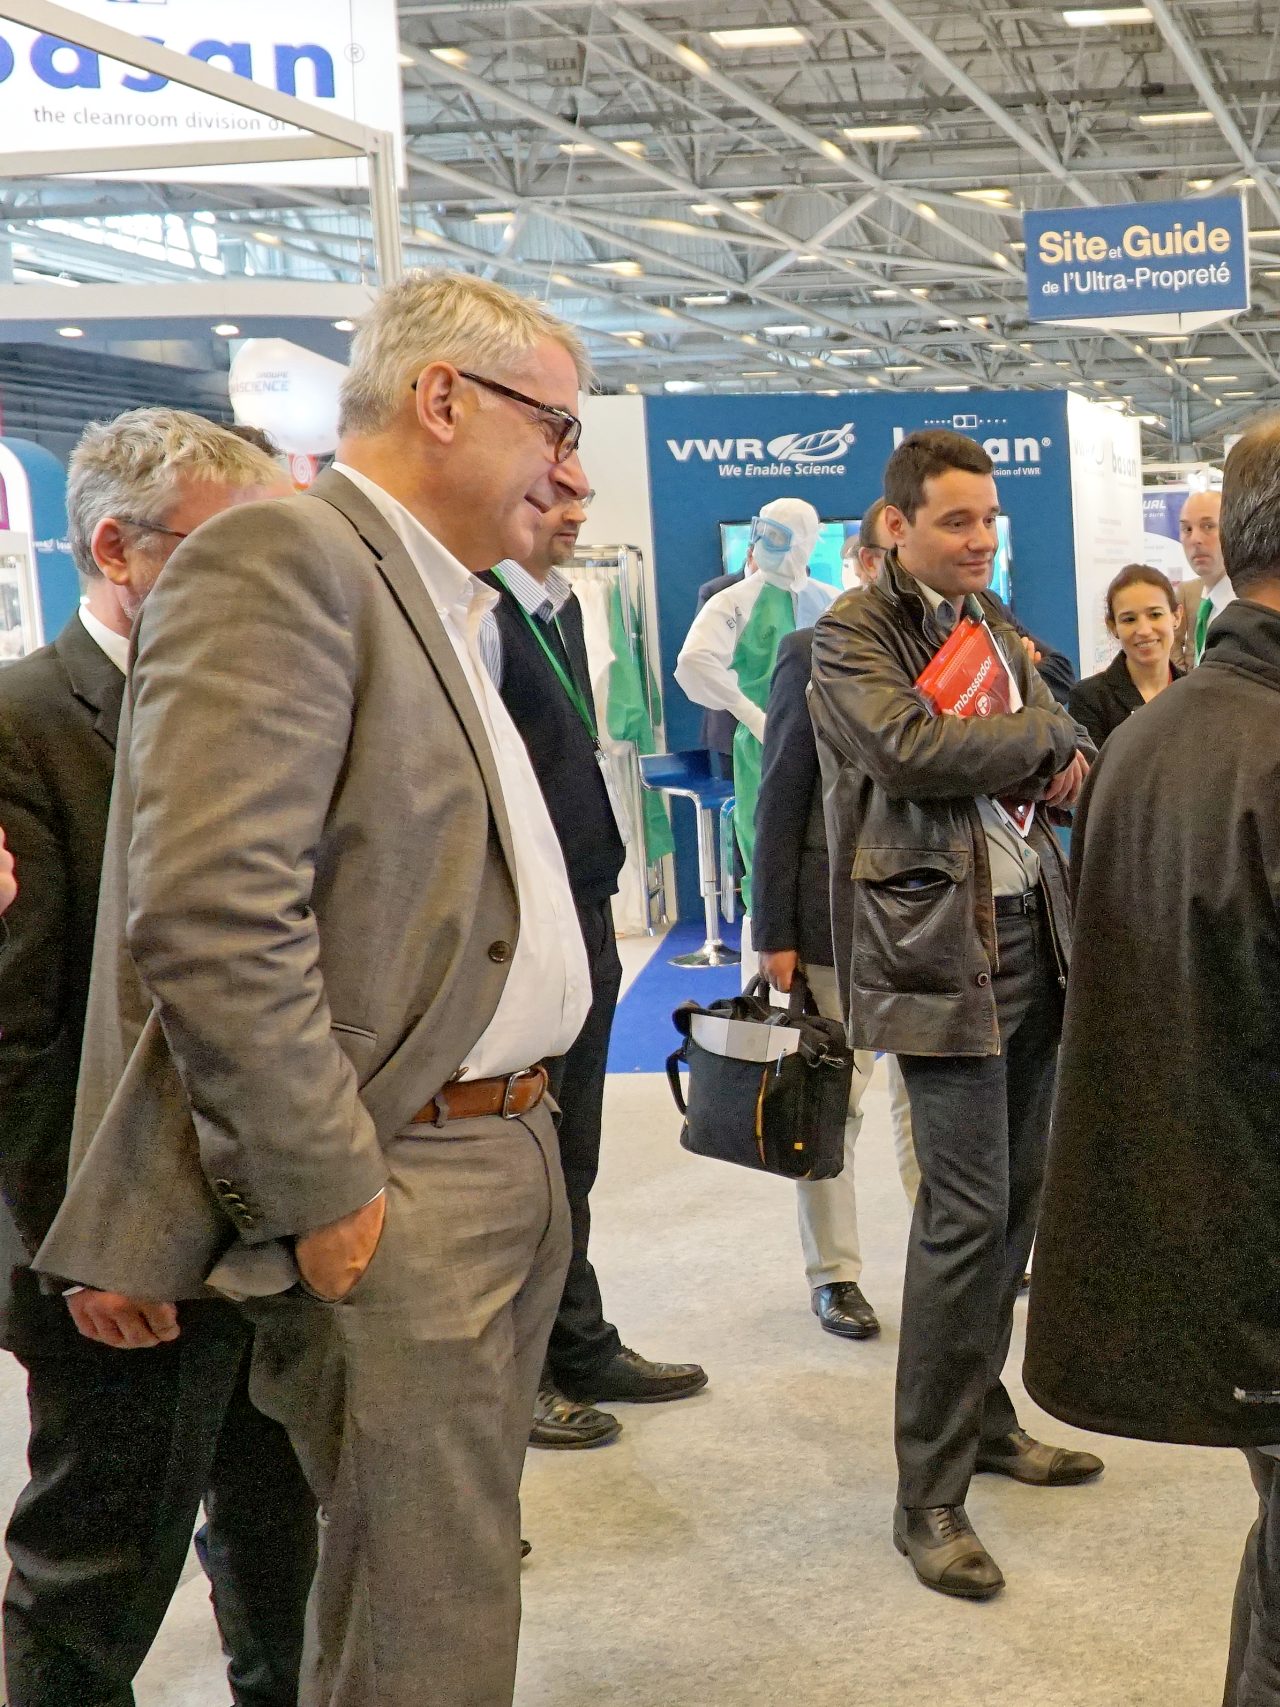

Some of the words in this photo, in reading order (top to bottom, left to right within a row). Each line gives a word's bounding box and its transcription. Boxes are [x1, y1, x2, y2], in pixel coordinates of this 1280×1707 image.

[33, 106, 65, 123] the
[74, 107, 178, 127] cleanroom
[185, 112, 261, 130] division
[1038, 230, 1108, 264] Site
[1108, 246, 1123, 259] et
[1122, 221, 1231, 258] Guide
[1042, 281, 1060, 295] de
[1063, 261, 1231, 293] l'Ultra-Propreté
[666, 438, 764, 462] VWR
[718, 464, 742, 477] We
[745, 463, 792, 477] Enable
[794, 462, 846, 475] Science
[1013, 468, 1021, 476] of
[1022, 468, 1041, 476] VWR
